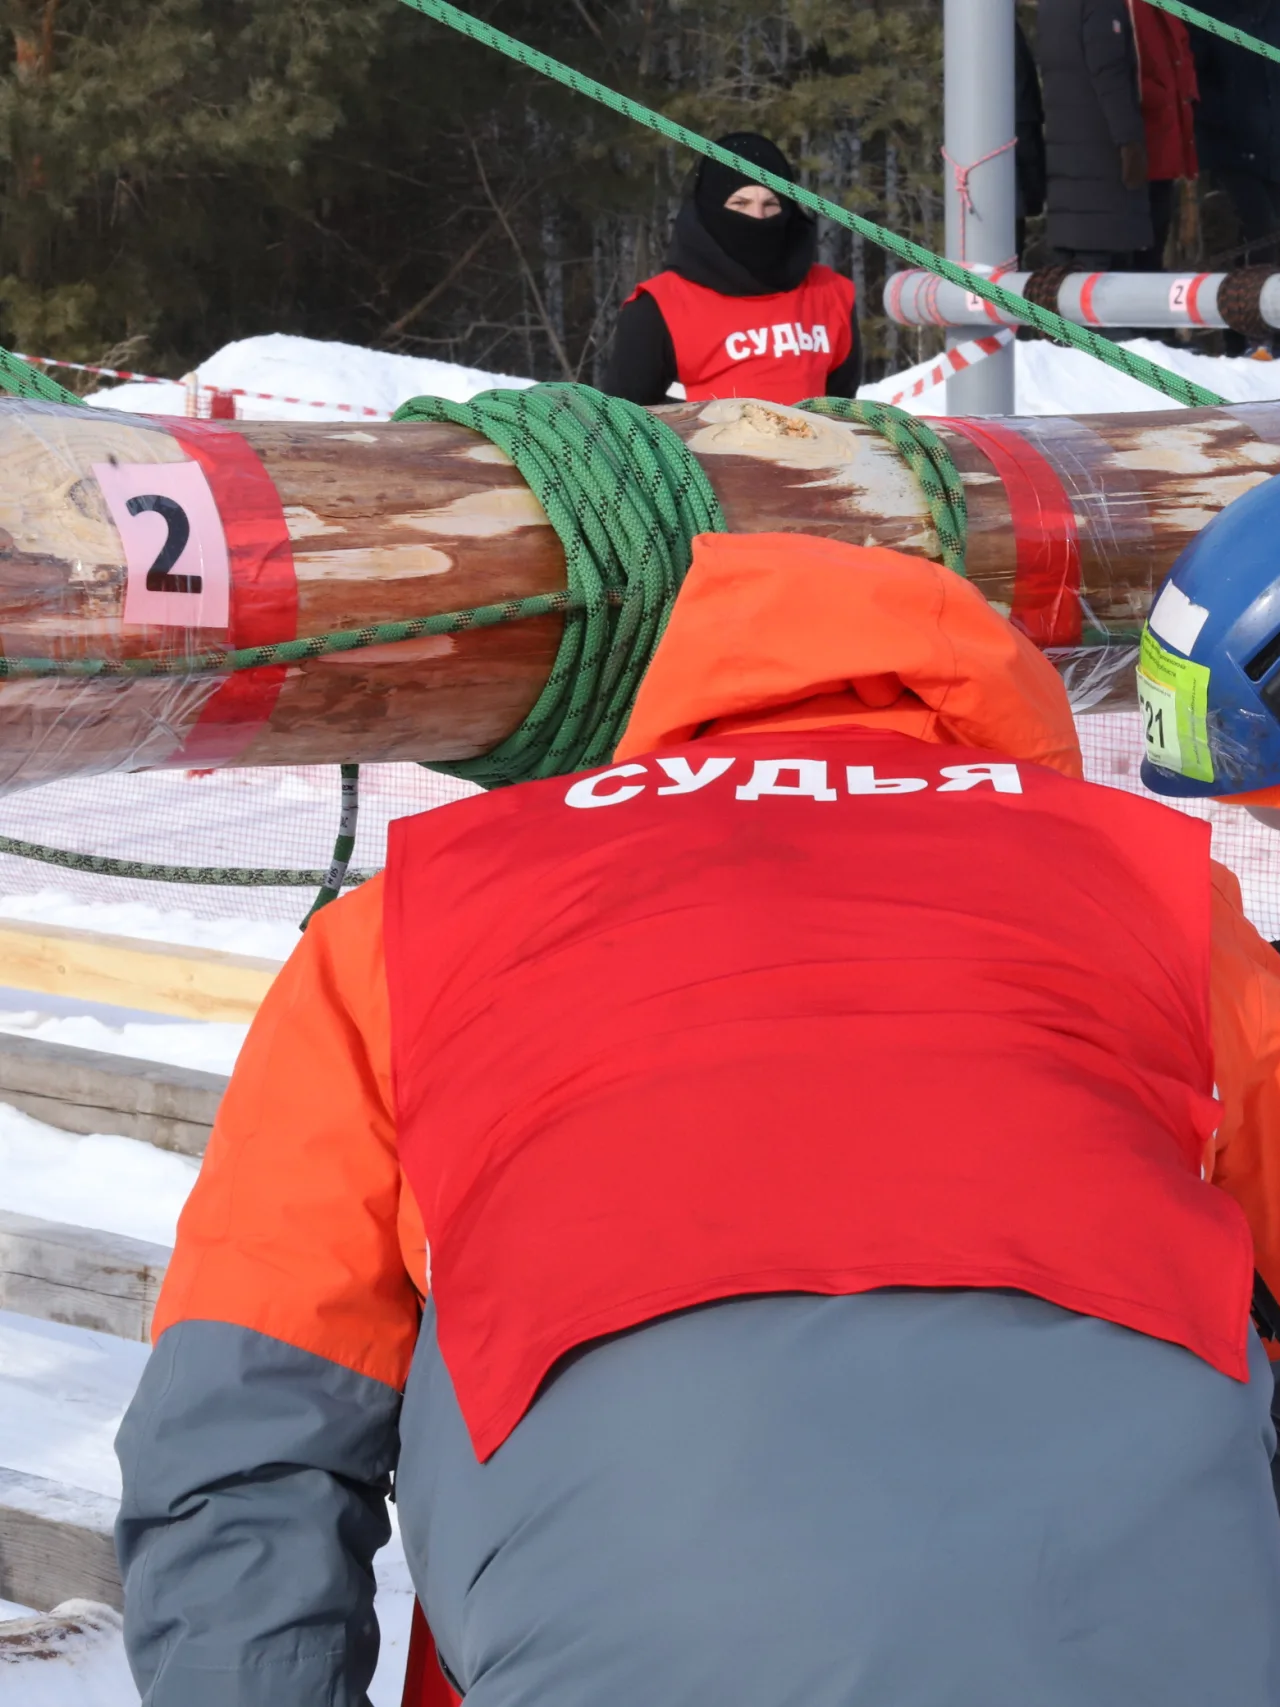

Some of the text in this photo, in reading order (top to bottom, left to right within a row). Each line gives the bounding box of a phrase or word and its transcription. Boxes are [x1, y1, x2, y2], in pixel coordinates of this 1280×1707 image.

[1173, 284, 1185, 305] 2
[725, 321, 831, 361] СУДЬЯ
[125, 494, 203, 594] 2
[1140, 694, 1165, 749] 21
[564, 757, 1024, 810] СУДЬЯ
